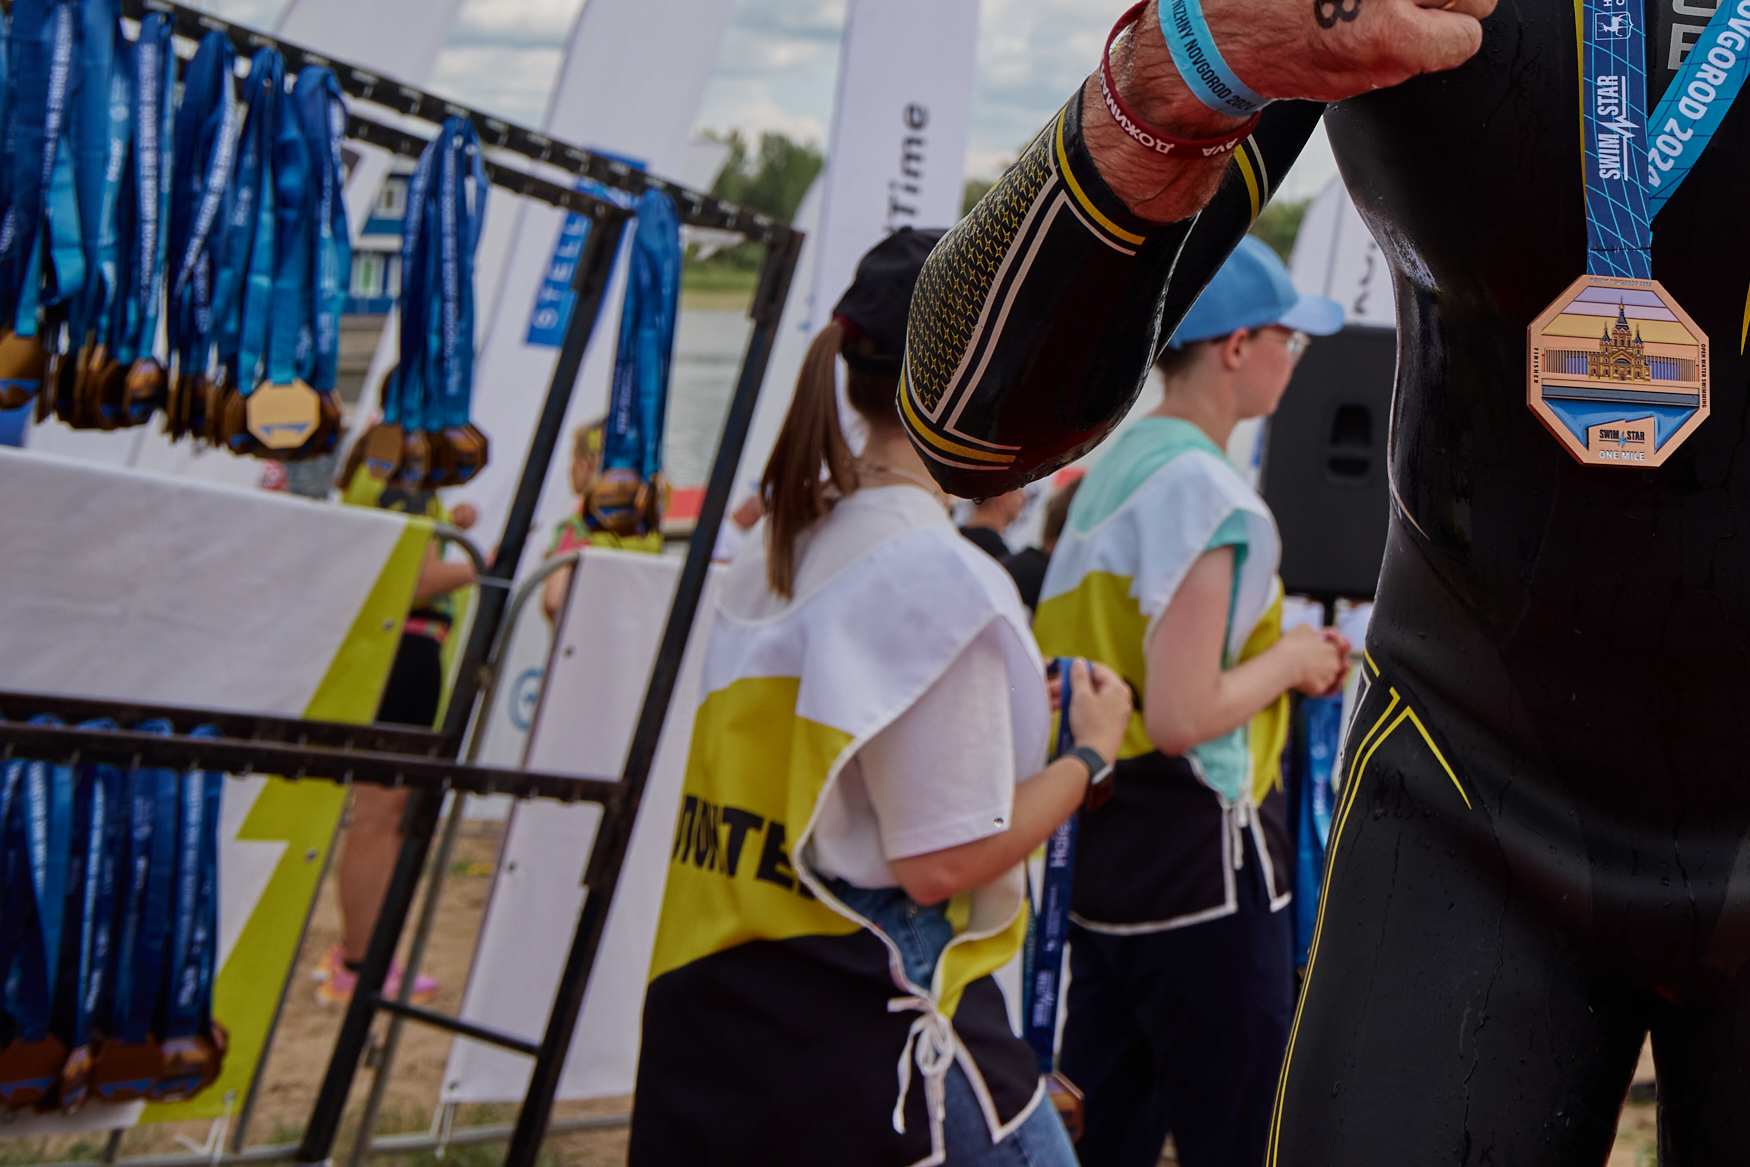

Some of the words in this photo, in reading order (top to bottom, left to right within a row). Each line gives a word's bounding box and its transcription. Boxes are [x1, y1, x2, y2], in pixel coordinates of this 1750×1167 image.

[1172, 0, 1194, 40] NIZHNY
[1184, 39, 1232, 99] NOVGOROD
[1597, 75, 1619, 117] STAR
[1598, 133, 1620, 181] SWIM
[1599, 429, 1620, 440] SWIM
[1626, 430, 1645, 441] STAR
[1599, 450, 1619, 460] ONE
[1621, 451, 1645, 461] MILE
